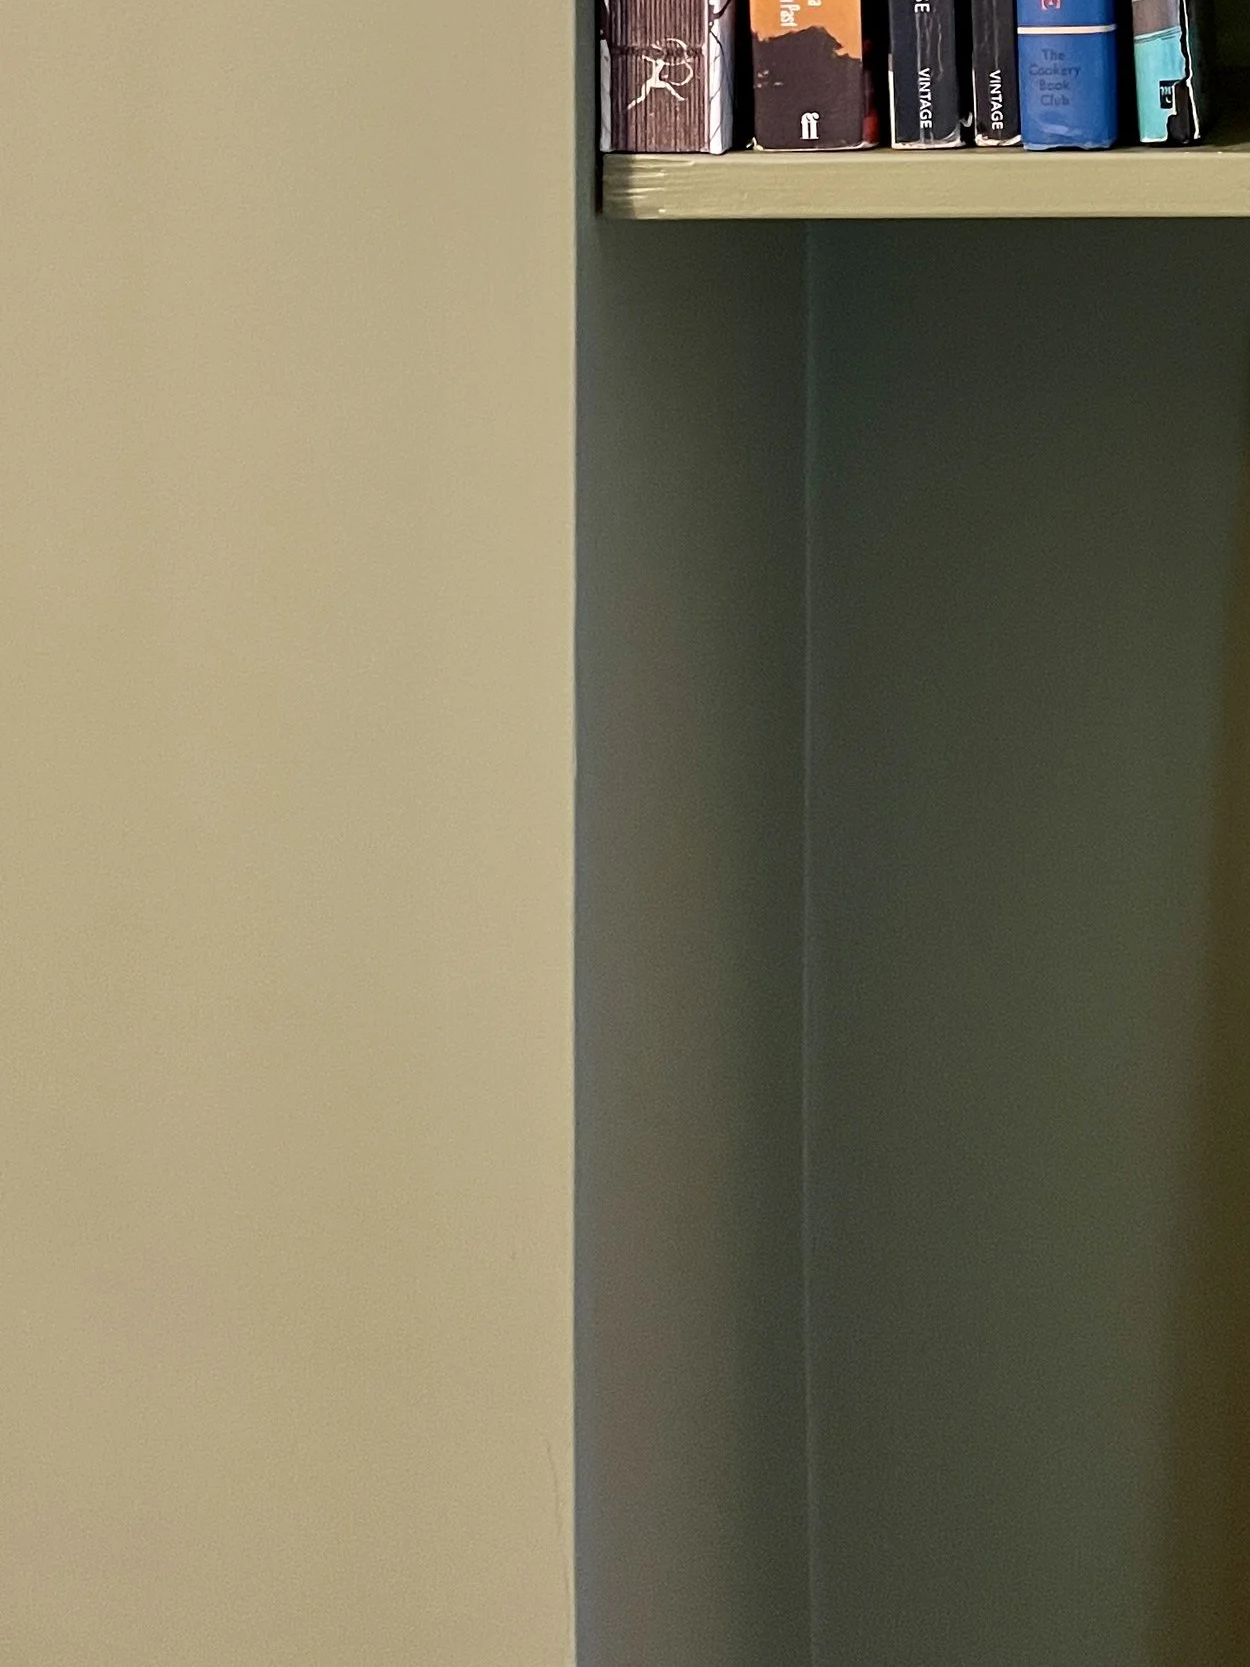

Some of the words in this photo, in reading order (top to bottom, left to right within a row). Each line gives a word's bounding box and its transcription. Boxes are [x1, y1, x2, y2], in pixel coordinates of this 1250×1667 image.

[780, 4, 801, 26] Past
[1041, 48, 1065, 62] The
[1028, 64, 1081, 77] Cookery
[1039, 79, 1071, 91] Book
[918, 67, 932, 129] VINTAGE
[989, 69, 1004, 130] VINTAGE
[1040, 94, 1070, 107] Club
